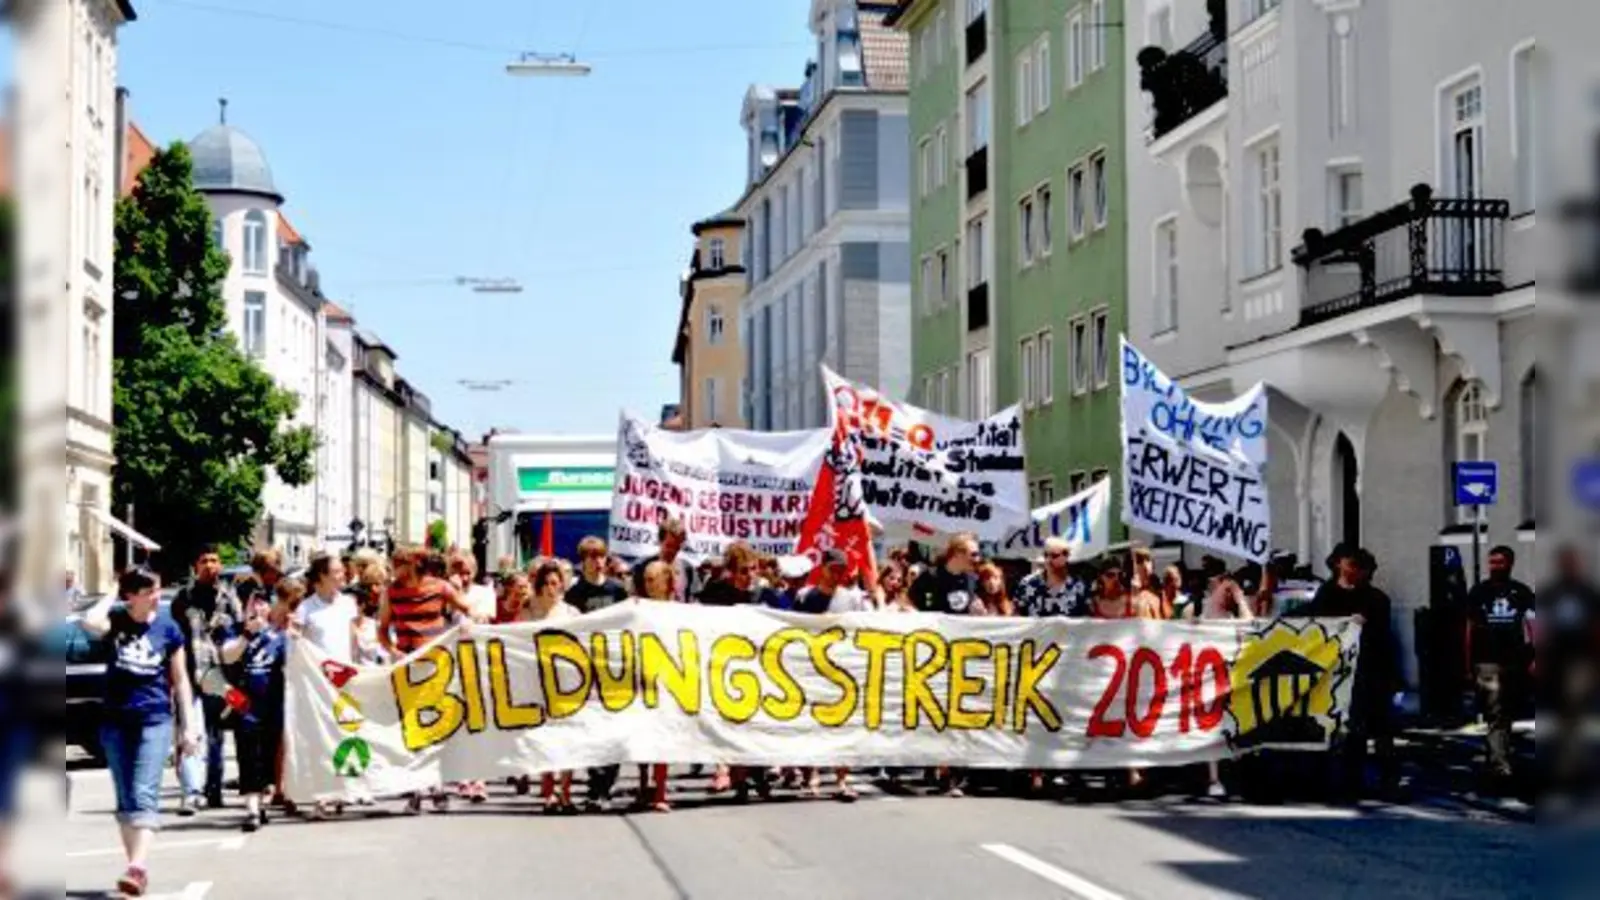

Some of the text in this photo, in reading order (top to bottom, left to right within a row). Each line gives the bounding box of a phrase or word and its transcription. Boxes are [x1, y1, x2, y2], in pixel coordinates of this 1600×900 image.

[618, 473, 694, 508] JUGEND
[698, 489, 762, 514] GEGEN
[393, 626, 1228, 752] BILDUNGSSTREIK 2010
